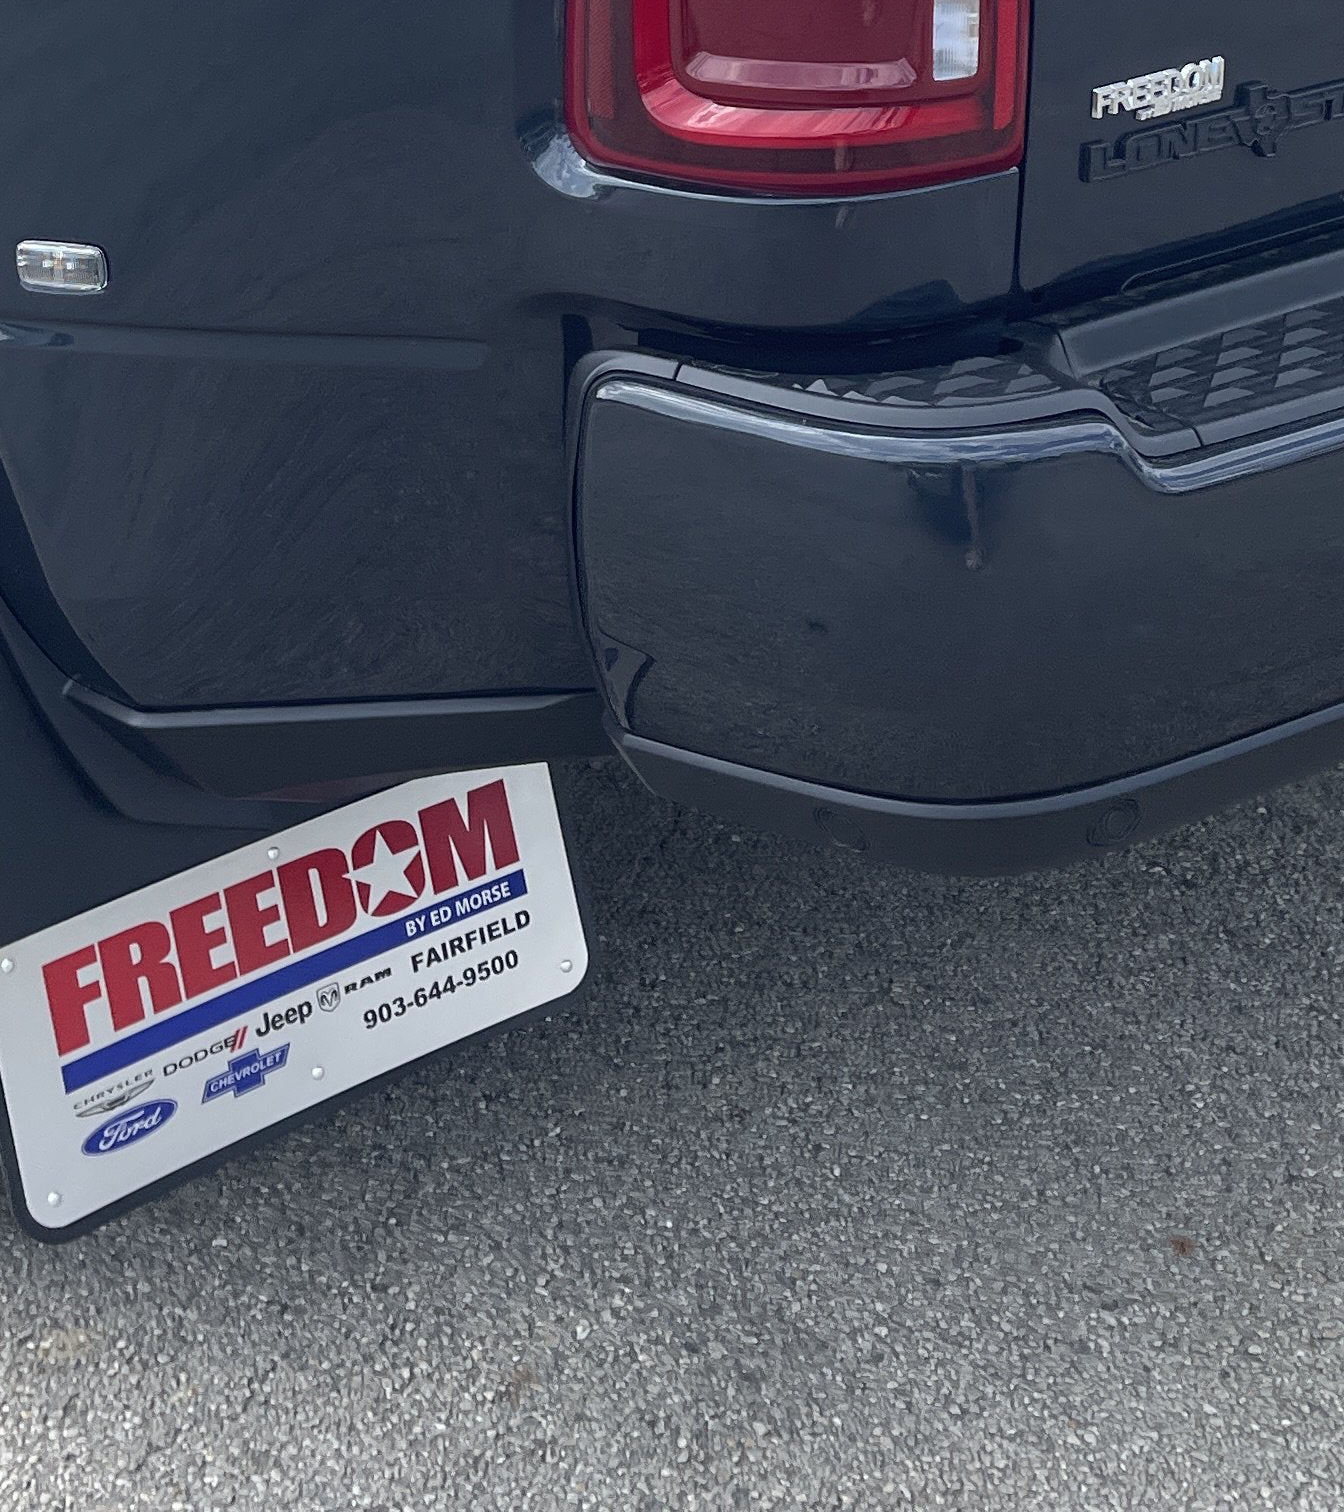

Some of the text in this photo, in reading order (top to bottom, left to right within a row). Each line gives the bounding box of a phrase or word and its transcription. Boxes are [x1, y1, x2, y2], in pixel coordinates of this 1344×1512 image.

[1091, 55, 1224, 119] FREEDOM
[41, 778, 521, 1058] FREEDOM
[405, 881, 512, 938] BY ED MORSE
[73, 909, 532, 1110] CHRYSLER DODGE Jeep RAM FAIRFIELD
[363, 949, 520, 1030] 903-644-9500
[99, 1051, 283, 1153] Ford CHEVROLET
